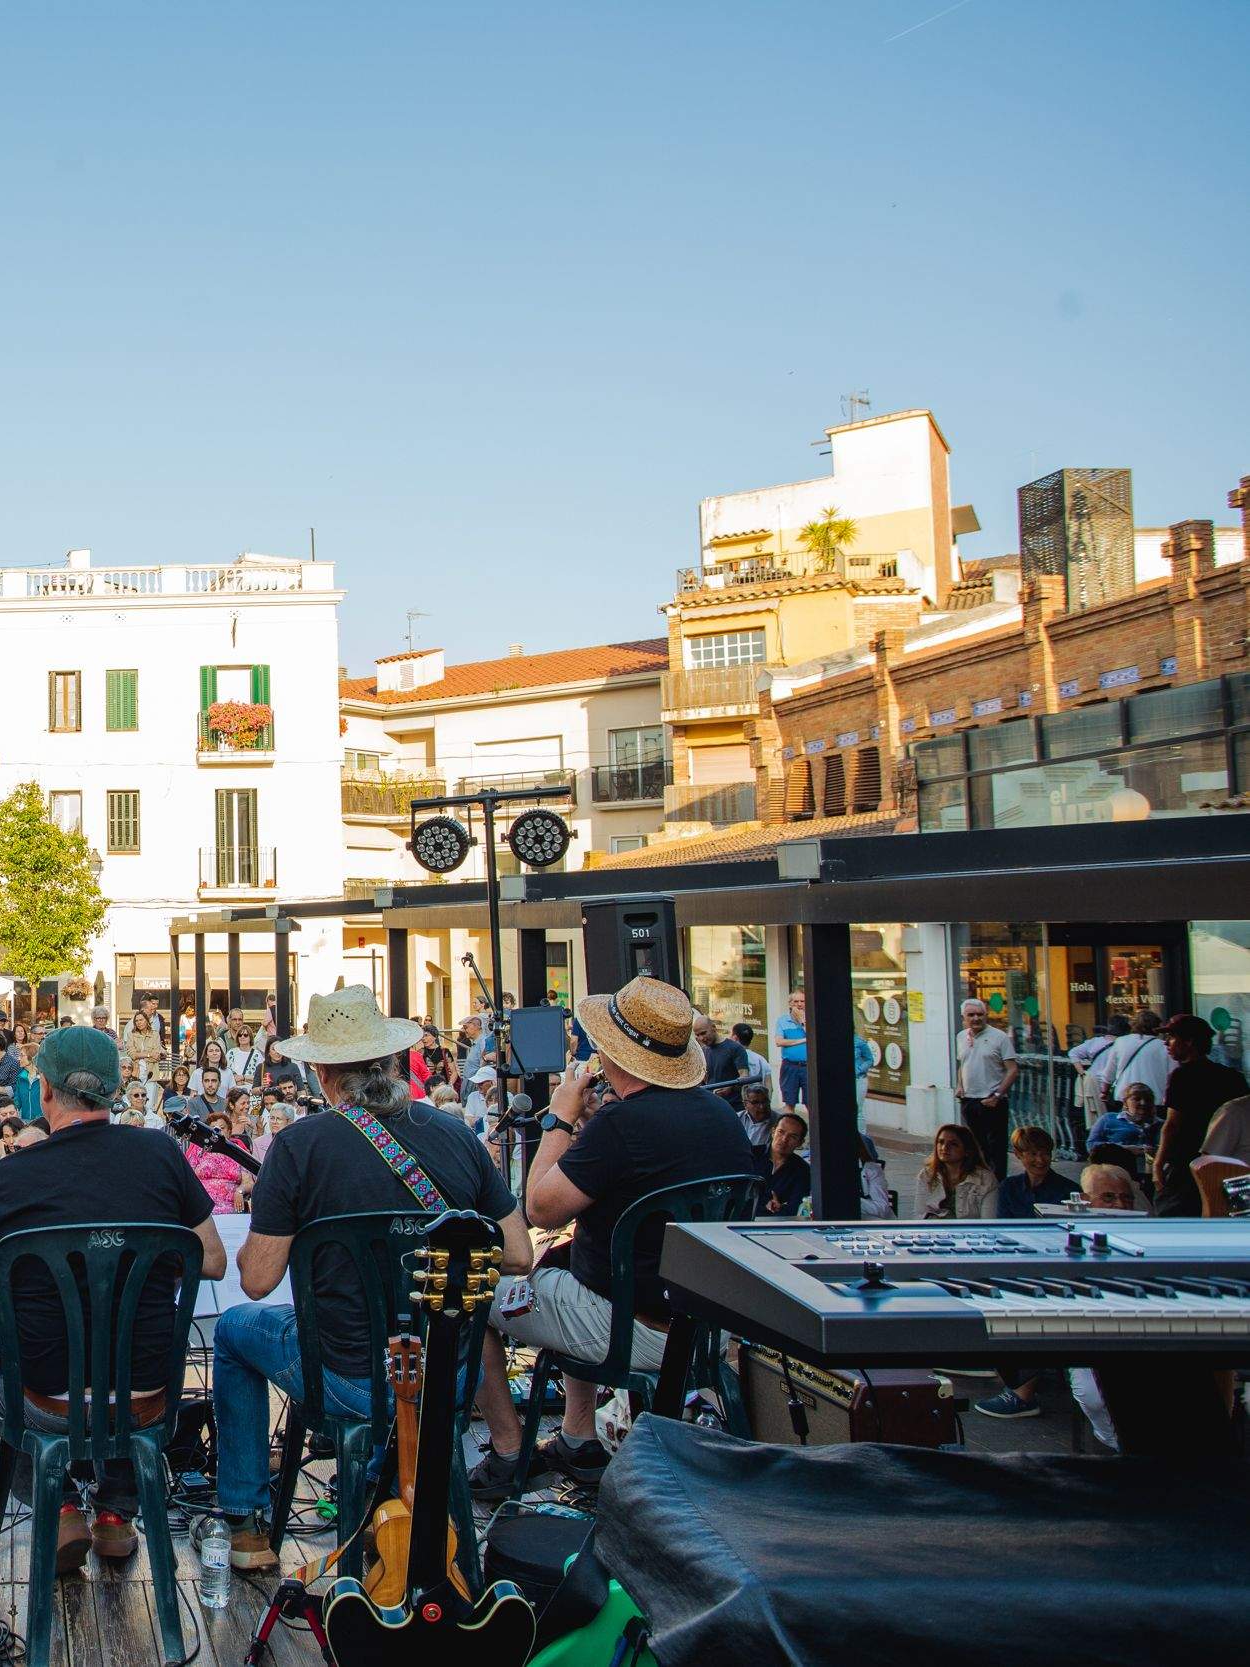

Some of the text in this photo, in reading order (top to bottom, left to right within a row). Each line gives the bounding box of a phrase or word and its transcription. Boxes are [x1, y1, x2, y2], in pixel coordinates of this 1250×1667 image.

[1049, 783, 1067, 805] el
[631, 928, 650, 938] 501
[1069, 982, 1095, 992] Hola
[623, 1023, 639, 1039] Cugat
[389, 1216, 427, 1235] ASC
[87, 1229, 126, 1249] ASC
